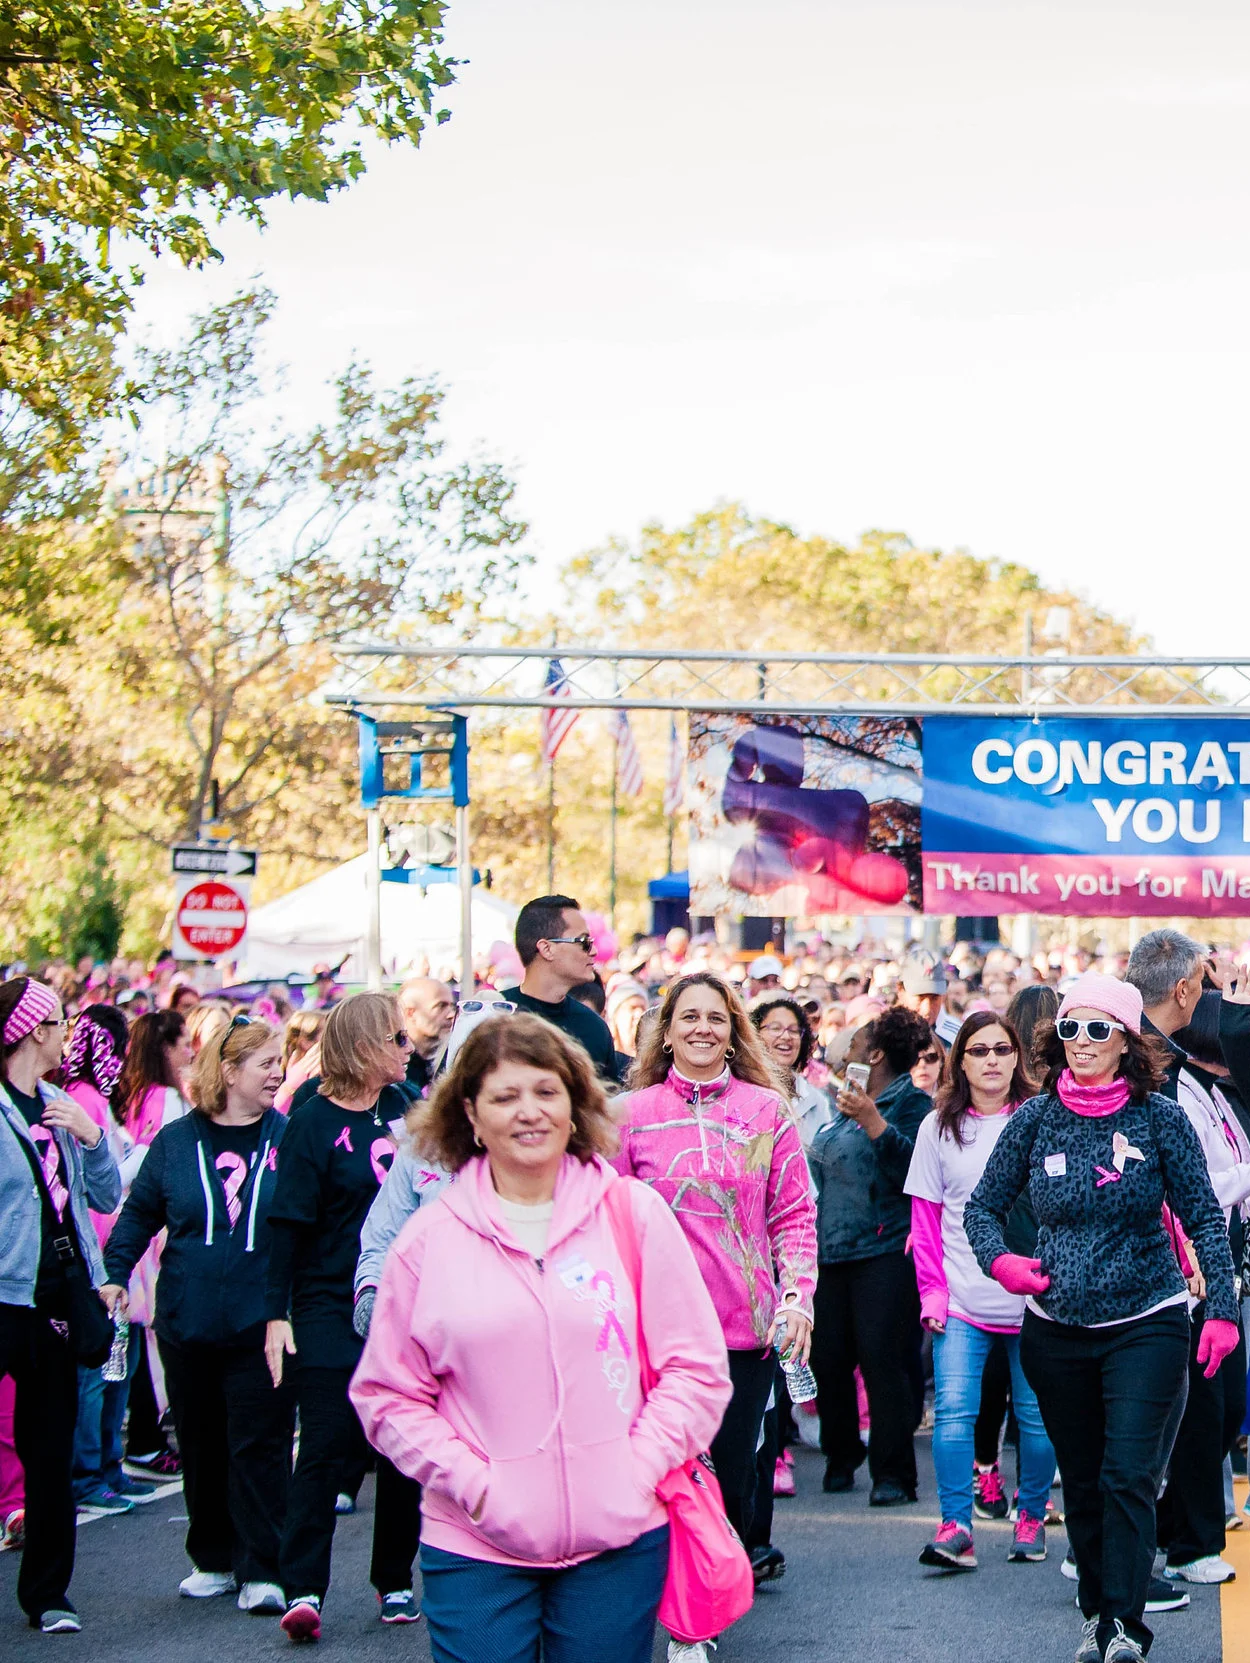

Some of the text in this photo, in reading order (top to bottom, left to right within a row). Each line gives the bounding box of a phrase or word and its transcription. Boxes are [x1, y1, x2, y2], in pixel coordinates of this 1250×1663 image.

[1092, 799, 1221, 843] YOU
[927, 861, 1040, 895] Thank
[1054, 874, 1121, 901] you
[1135, 868, 1187, 897] for
[186, 893, 239, 910] DO NOT
[190, 927, 235, 944] ENTER
